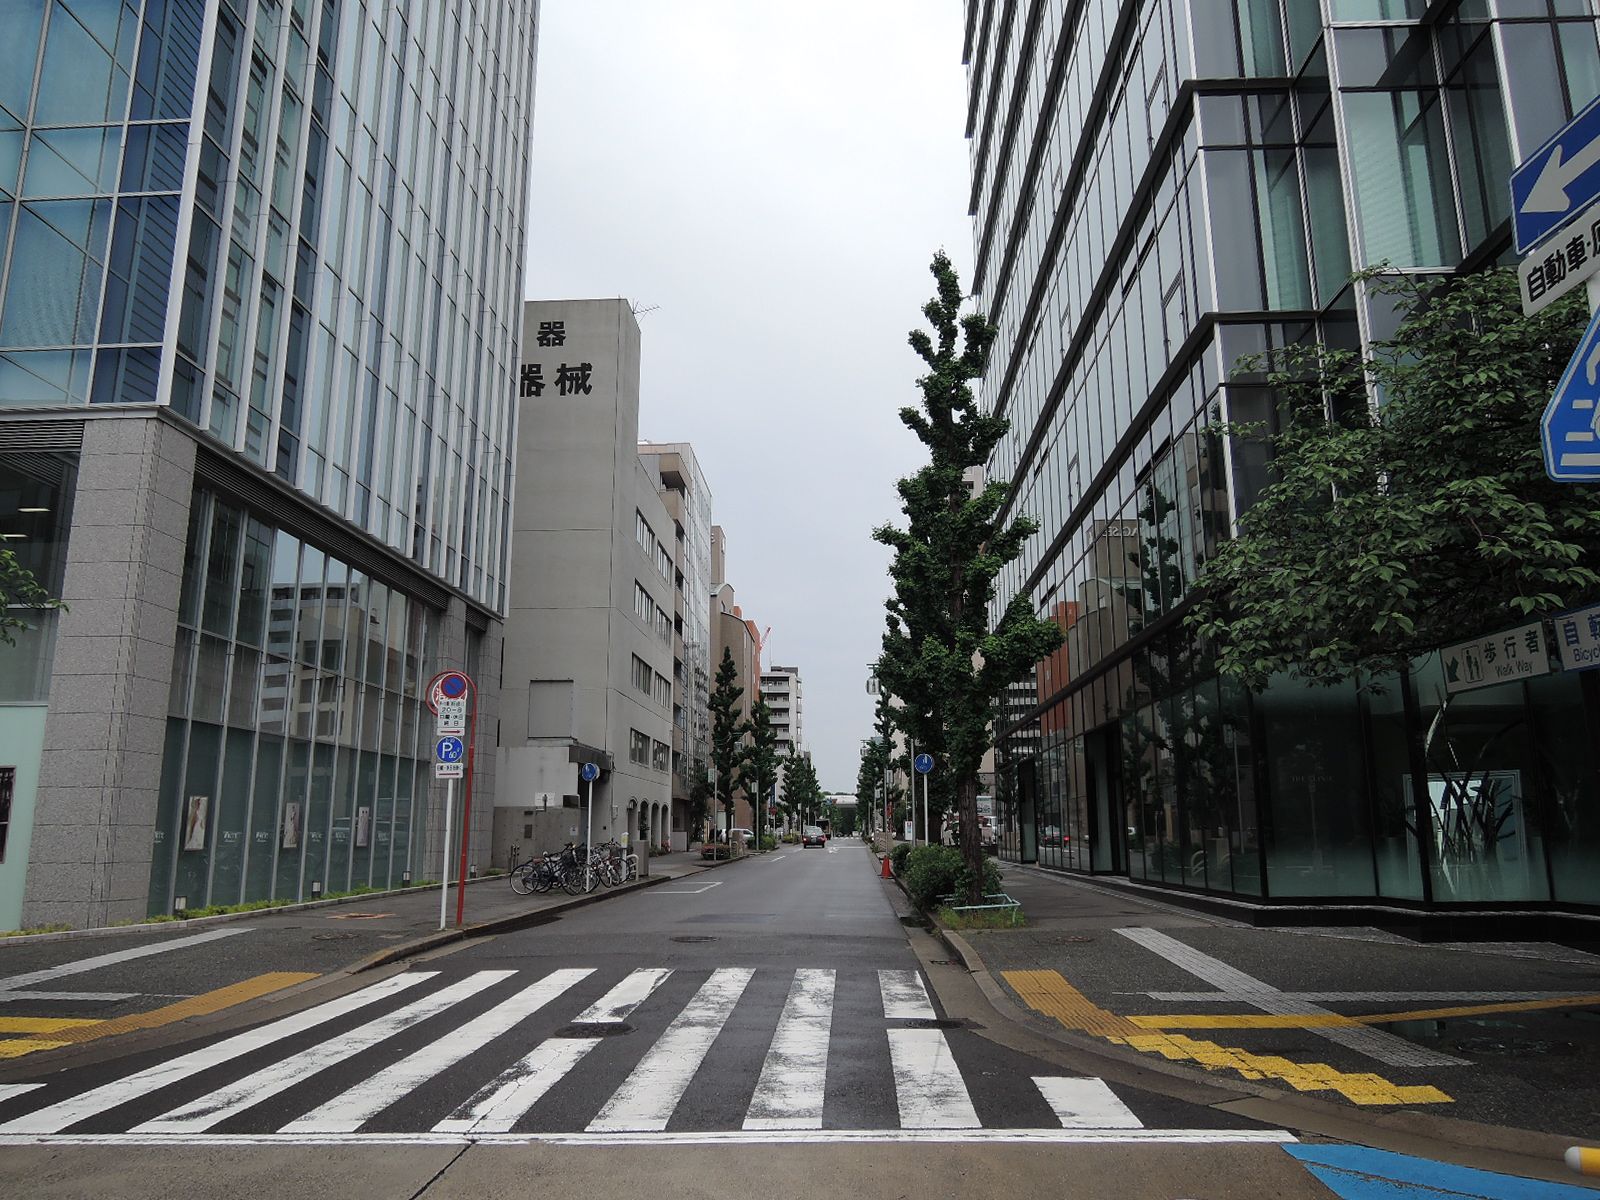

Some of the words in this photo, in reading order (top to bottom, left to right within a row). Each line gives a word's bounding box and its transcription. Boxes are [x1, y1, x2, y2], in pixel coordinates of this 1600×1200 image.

[536, 321, 566, 347] 器
[1484, 629, 1540, 664] 歩行者
[1495, 663, 1514, 677] Walk
[1516, 659, 1534, 674] Way
[441, 742, 453, 759] P
